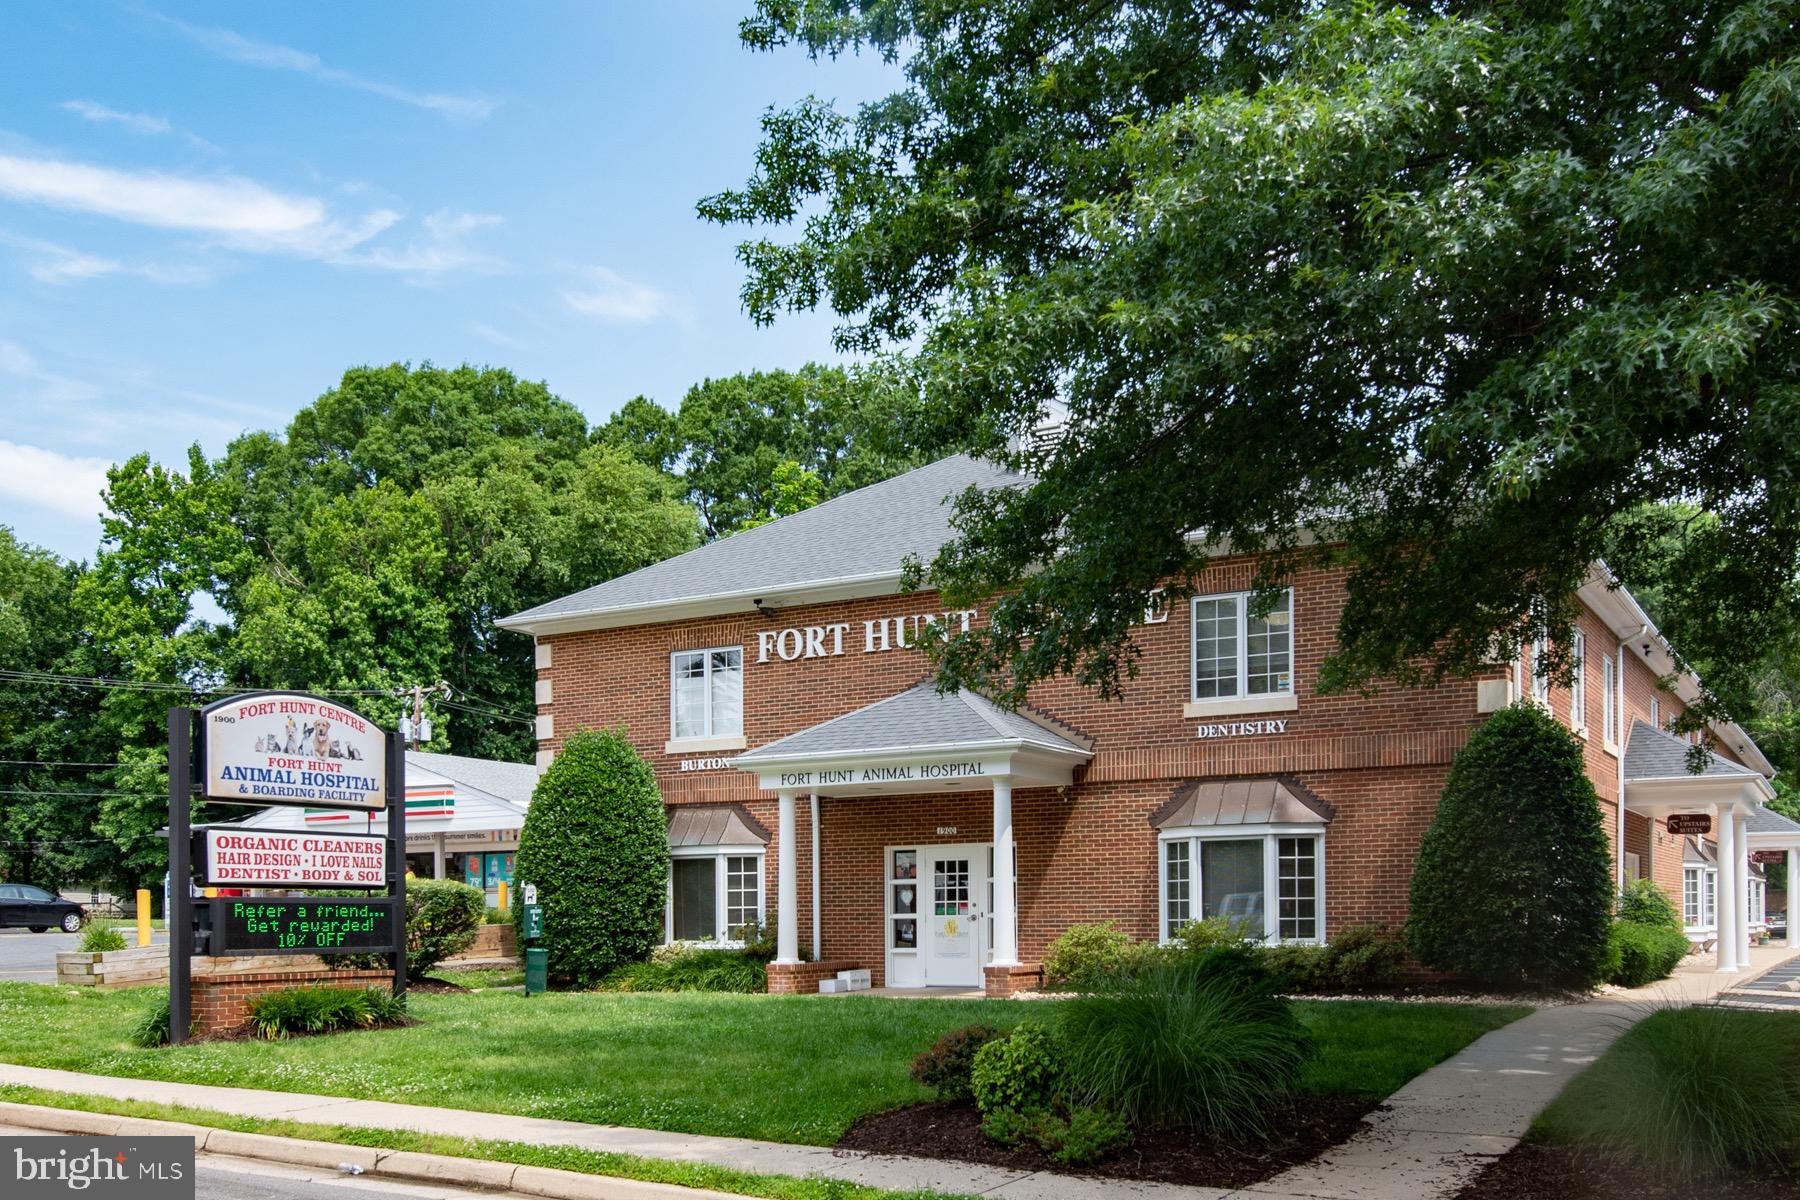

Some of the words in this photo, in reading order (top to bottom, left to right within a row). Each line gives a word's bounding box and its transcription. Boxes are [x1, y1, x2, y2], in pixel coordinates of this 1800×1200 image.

[756, 622, 850, 664] FORT
[214, 715, 236, 724] 1900
[239, 702, 276, 719] FORT
[279, 701, 316, 715] HUNT
[319, 705, 366, 734] CENTRE
[1197, 719, 1288, 738] DENTISTRY
[268, 757, 304, 769] FORT
[308, 760, 343, 773] HUNT
[681, 757, 730, 771] BURTON
[220, 765, 296, 784] ANIMAL
[300, 771, 380, 792] HOSPITAL
[781, 772, 813, 786] FORT
[819, 769, 855, 784] HUNT
[862, 766, 914, 781] ANIMAL
[920, 762, 985, 778] HOSPITAL
[238, 784, 249, 794] &
[252, 784, 315, 799] BOARDING
[318, 790, 366, 802] FACILITY
[216, 836, 298, 851] ORGANIC
[303, 840, 383, 854] CLEANERS
[217, 852, 251, 865] HAIR
[254, 853, 302, 866] DESIGN
[311, 856, 316, 867] I
[321, 855, 350, 868] LOVE
[352, 856, 383, 869] NAILS
[217, 868, 291, 880] DENTIST
[302, 870, 340, 881] BODY
[343, 870, 354, 881] &
[357, 871, 382, 882] SOL
[234, 903, 287, 918] Refer
[297, 906, 307, 917] a
[316, 905, 385, 918] friend...
[247, 918, 280, 933] Get
[289, 919, 375, 933] rewarded!
[278, 933, 306, 948] 10%
[316, 932, 346, 947] OFF
